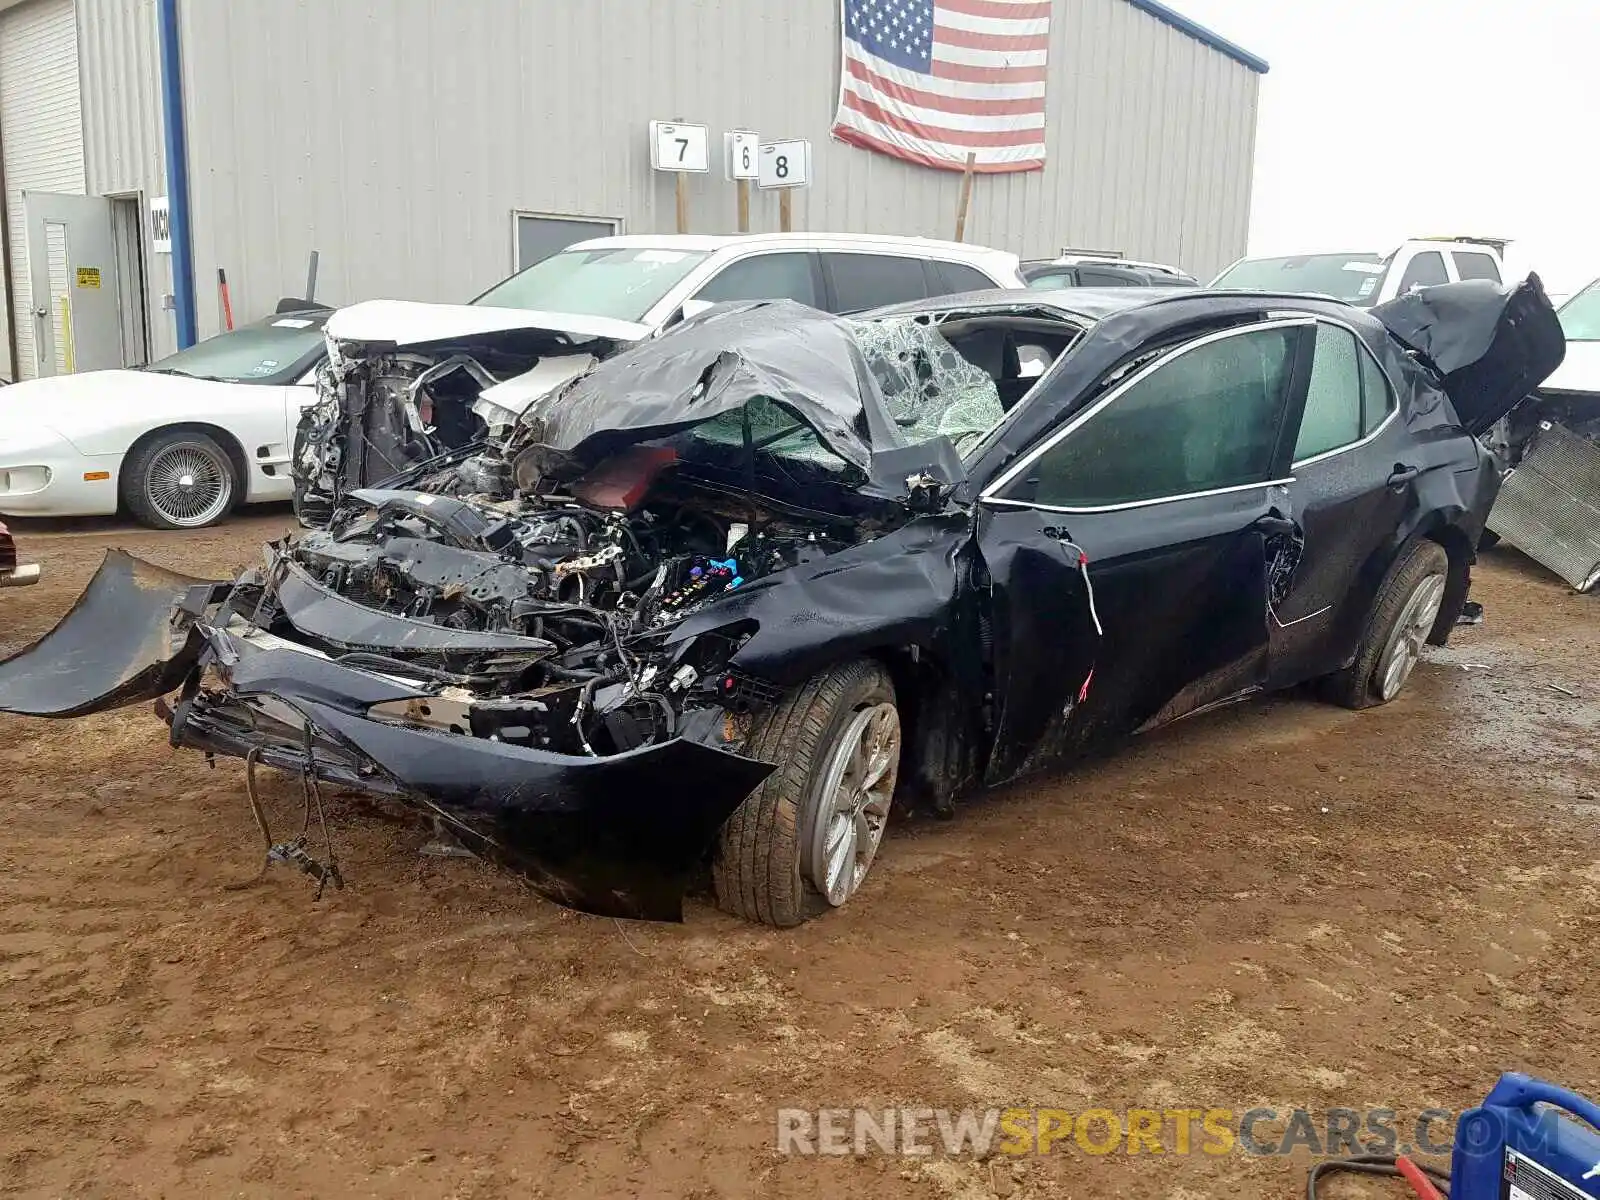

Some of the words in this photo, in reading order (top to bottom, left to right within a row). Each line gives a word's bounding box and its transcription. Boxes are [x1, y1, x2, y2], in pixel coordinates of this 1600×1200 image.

[674, 138, 689, 162] 7
[742, 146, 750, 170] 6
[775, 156, 789, 178] 8
